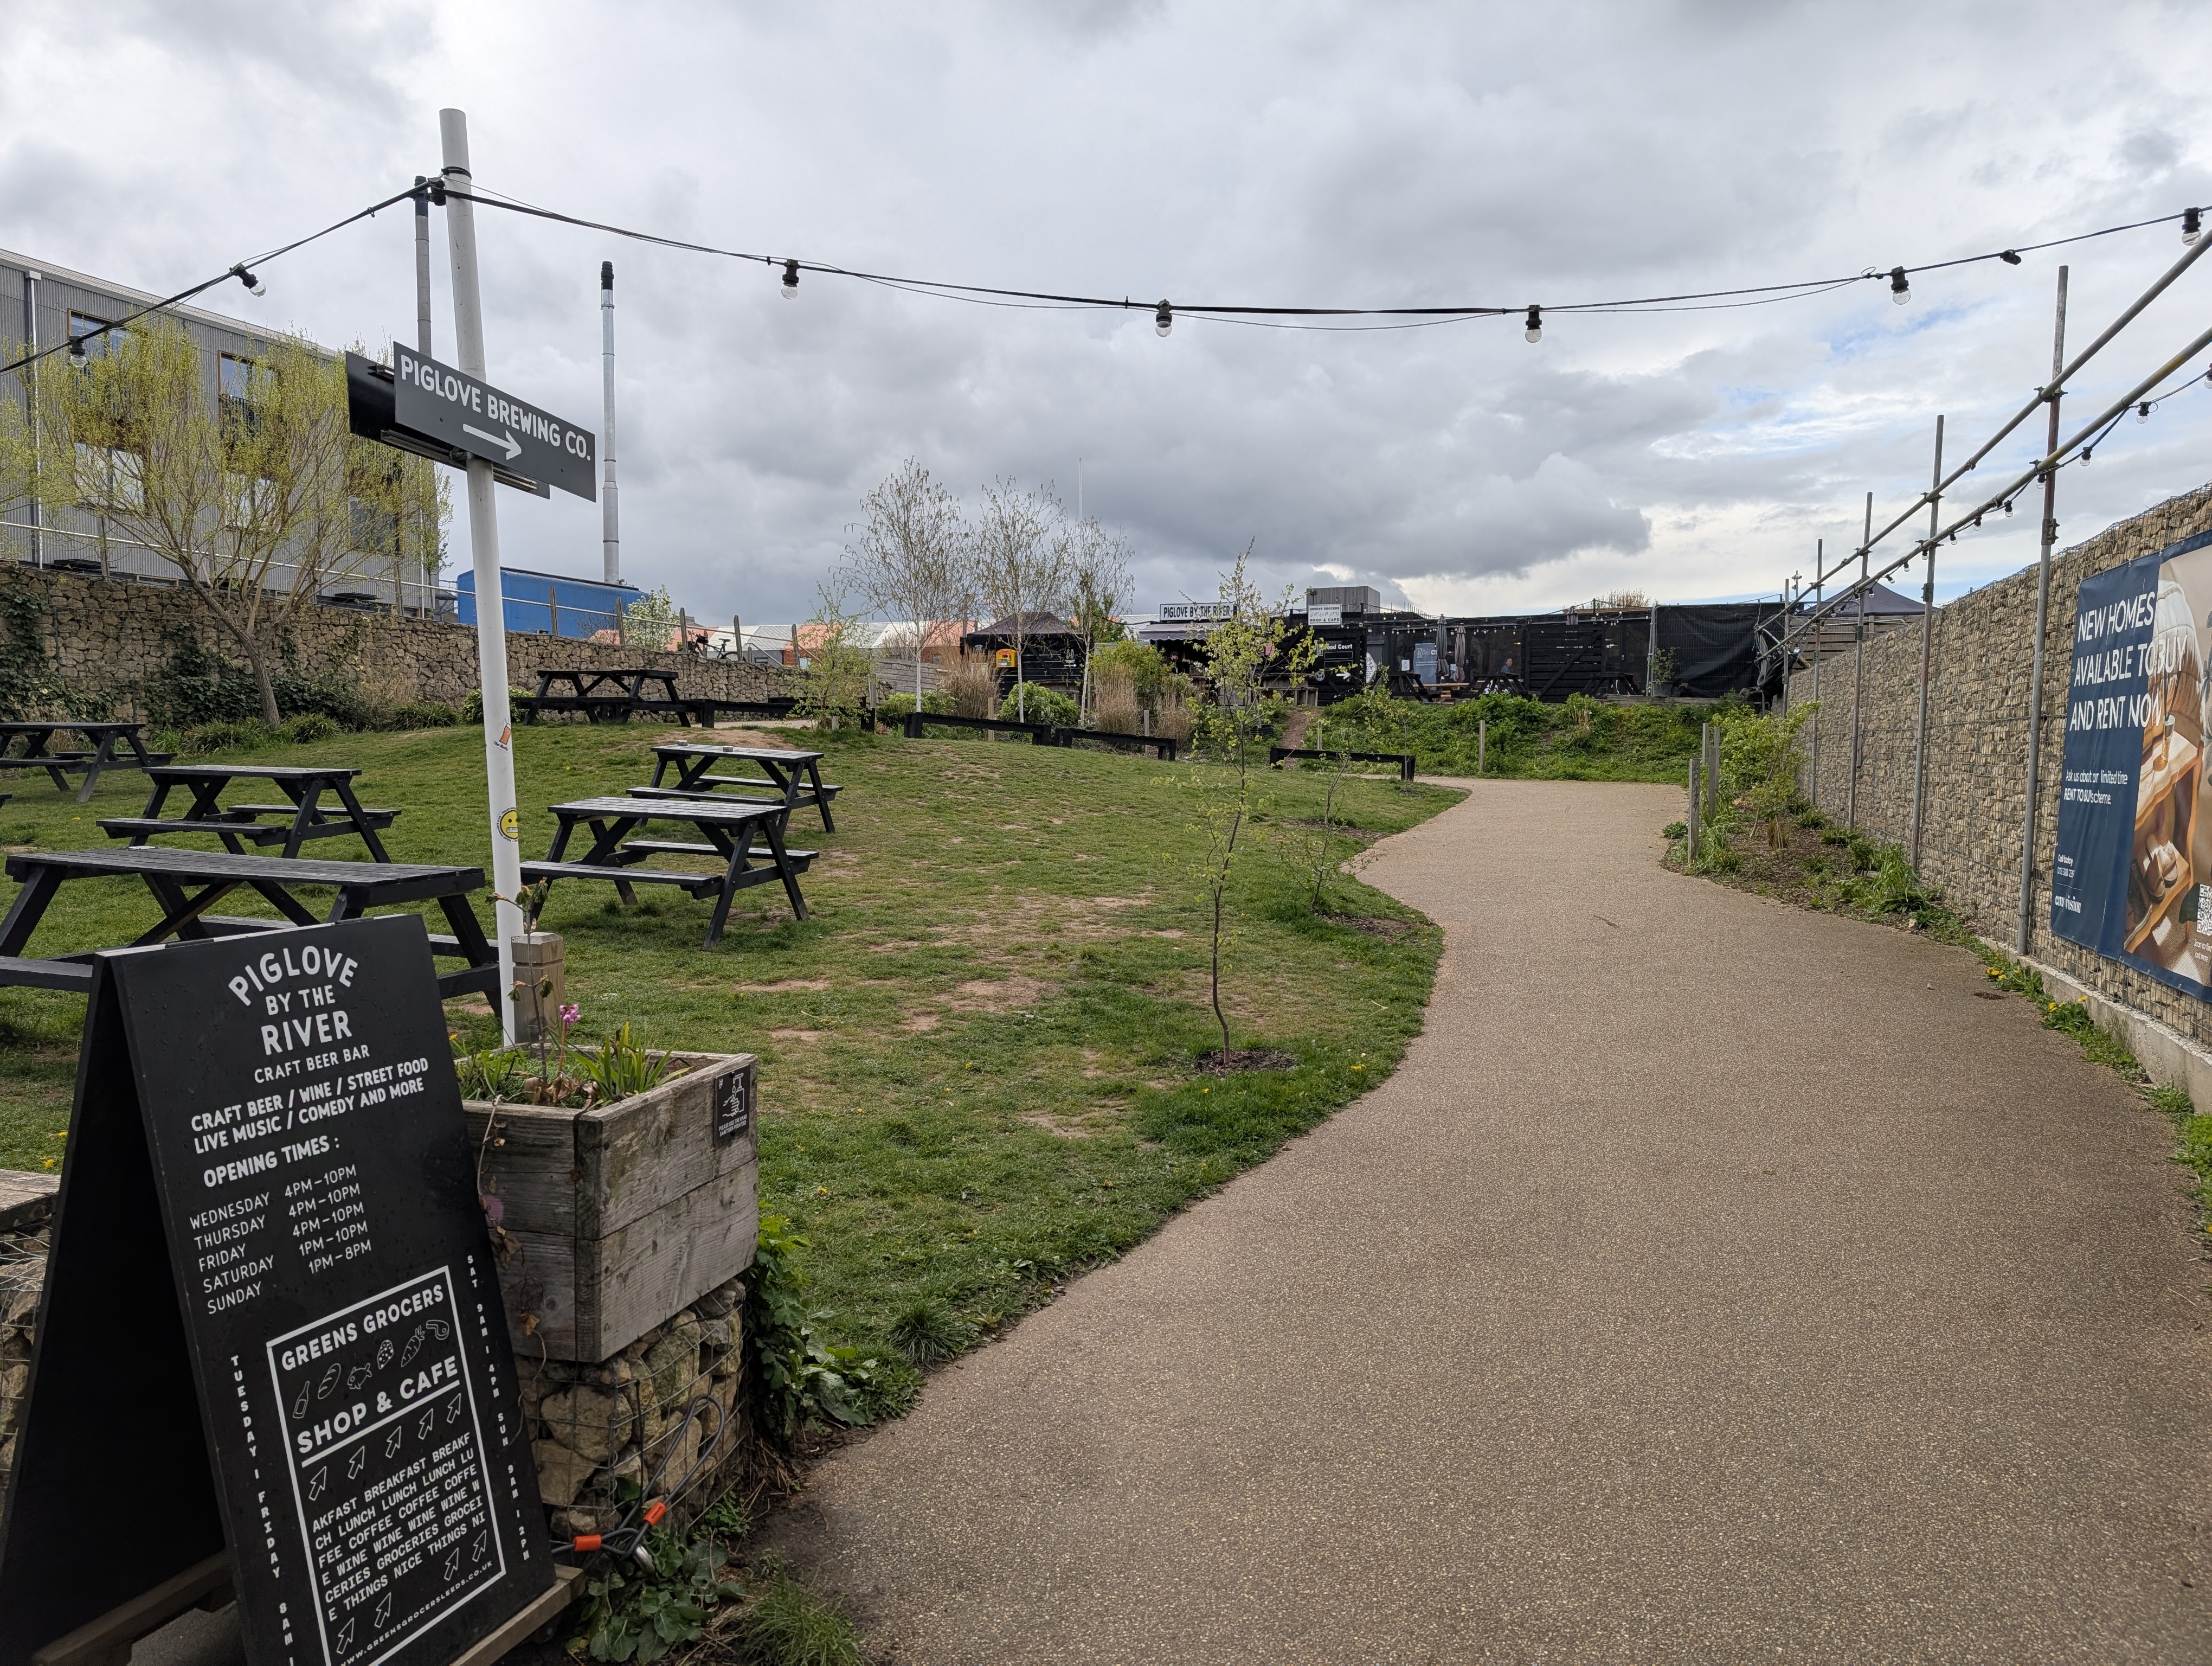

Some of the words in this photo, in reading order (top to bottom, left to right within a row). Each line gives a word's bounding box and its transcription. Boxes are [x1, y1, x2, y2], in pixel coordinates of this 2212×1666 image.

[401, 354, 481, 413] PIGLOVE
[487, 394, 561, 447] BREWING
[565, 431, 591, 461] CO.
[1163, 606, 1188, 618] PIGLOVE
[1190, 606, 1198, 617] BY
[1200, 606, 1211, 617] THE
[2078, 606, 2107, 643] NEW
[2107, 591, 2156, 635] HOMES
[2074, 645, 2133, 687] AVAILABLE
[2069, 700, 2094, 731] AND
[2097, 696, 2127, 730] RENT
[2128, 693, 2162, 728] NOW
[2063, 787, 2077, 801] RENT
[2074, 772, 2080, 782] us
[228, 946, 358, 1007] PIGLOVE
[265, 992, 291, 1016] BY
[298, 984, 336, 1008] THE
[261, 1010, 353, 1055] RIVER
[254, 1060, 300, 1084] CRAFT
[306, 1052, 339, 1071] BEER
[343, 1045, 370, 1062] BAR
[191, 1104, 242, 1132] CRAFT
[247, 1094, 284, 1117] BEER
[299, 1081, 332, 1103] WINE
[347, 1065, 394, 1091] STREET
[397, 1058, 428, 1078] FOOD
[194, 1130, 229, 1154] LIVE
[232, 1116, 282, 1143] MUSIC
[298, 1095, 355, 1124] COMEDY
[360, 1087, 387, 1108] AND
[389, 1077, 425, 1099] MORE
[718, 1122, 729, 1132] PLEASE
[203, 1151, 278, 1188] OPENING
[281, 1135, 330, 1163] TIMES
[189, 1191, 269, 1230] WEDNESDAY
[194, 1214, 265, 1251] THURSDAY
[198, 1243, 246, 1272] FRIDAY
[203, 1254, 274, 1293] SATURDAY
[207, 1281, 261, 1315] SUNDAY
[281, 1322, 358, 1370] GREENS
[363, 1284, 443, 1334] GROCERS
[297, 1402, 366, 1453] SHOP
[377, 1391, 393, 1413] &
[400, 1355, 458, 1399] CAFE
[313, 1497, 357, 1533] AKFAST
[364, 1457, 426, 1503] BREAKFAST
[432, 1432, 470, 1463] BREAKF
[315, 1532, 332, 1550] CH
[338, 1505, 376, 1537] LUNCH
[381, 1481, 417, 1511] LUNCH
[422, 1458, 456, 1486] LUNCH
[460, 1447, 474, 1464] LU
[318, 1545, 343, 1568] FEE
[349, 1514, 393, 1549] COFFEE
[398, 1486, 440, 1519] COFFEE
[445, 1463, 477, 1491] COFFE
[321, 1572, 331, 1586] E
[336, 1548, 368, 1577] WINE
[373, 1527, 403, 1554] WINE
[408, 1506, 436, 1532] WINE
[440, 1486, 468, 1511] WINE
[472, 1479, 480, 1492] W
[325, 1566, 371, 1603] CERIES
[377, 1523, 439, 1570] GROCERIES
[328, 1607, 337, 1622] E
[343, 1574, 388, 1611] THINGS
[394, 1552, 422, 1579] NICE
[427, 1523, 467, 1555] THINGS
